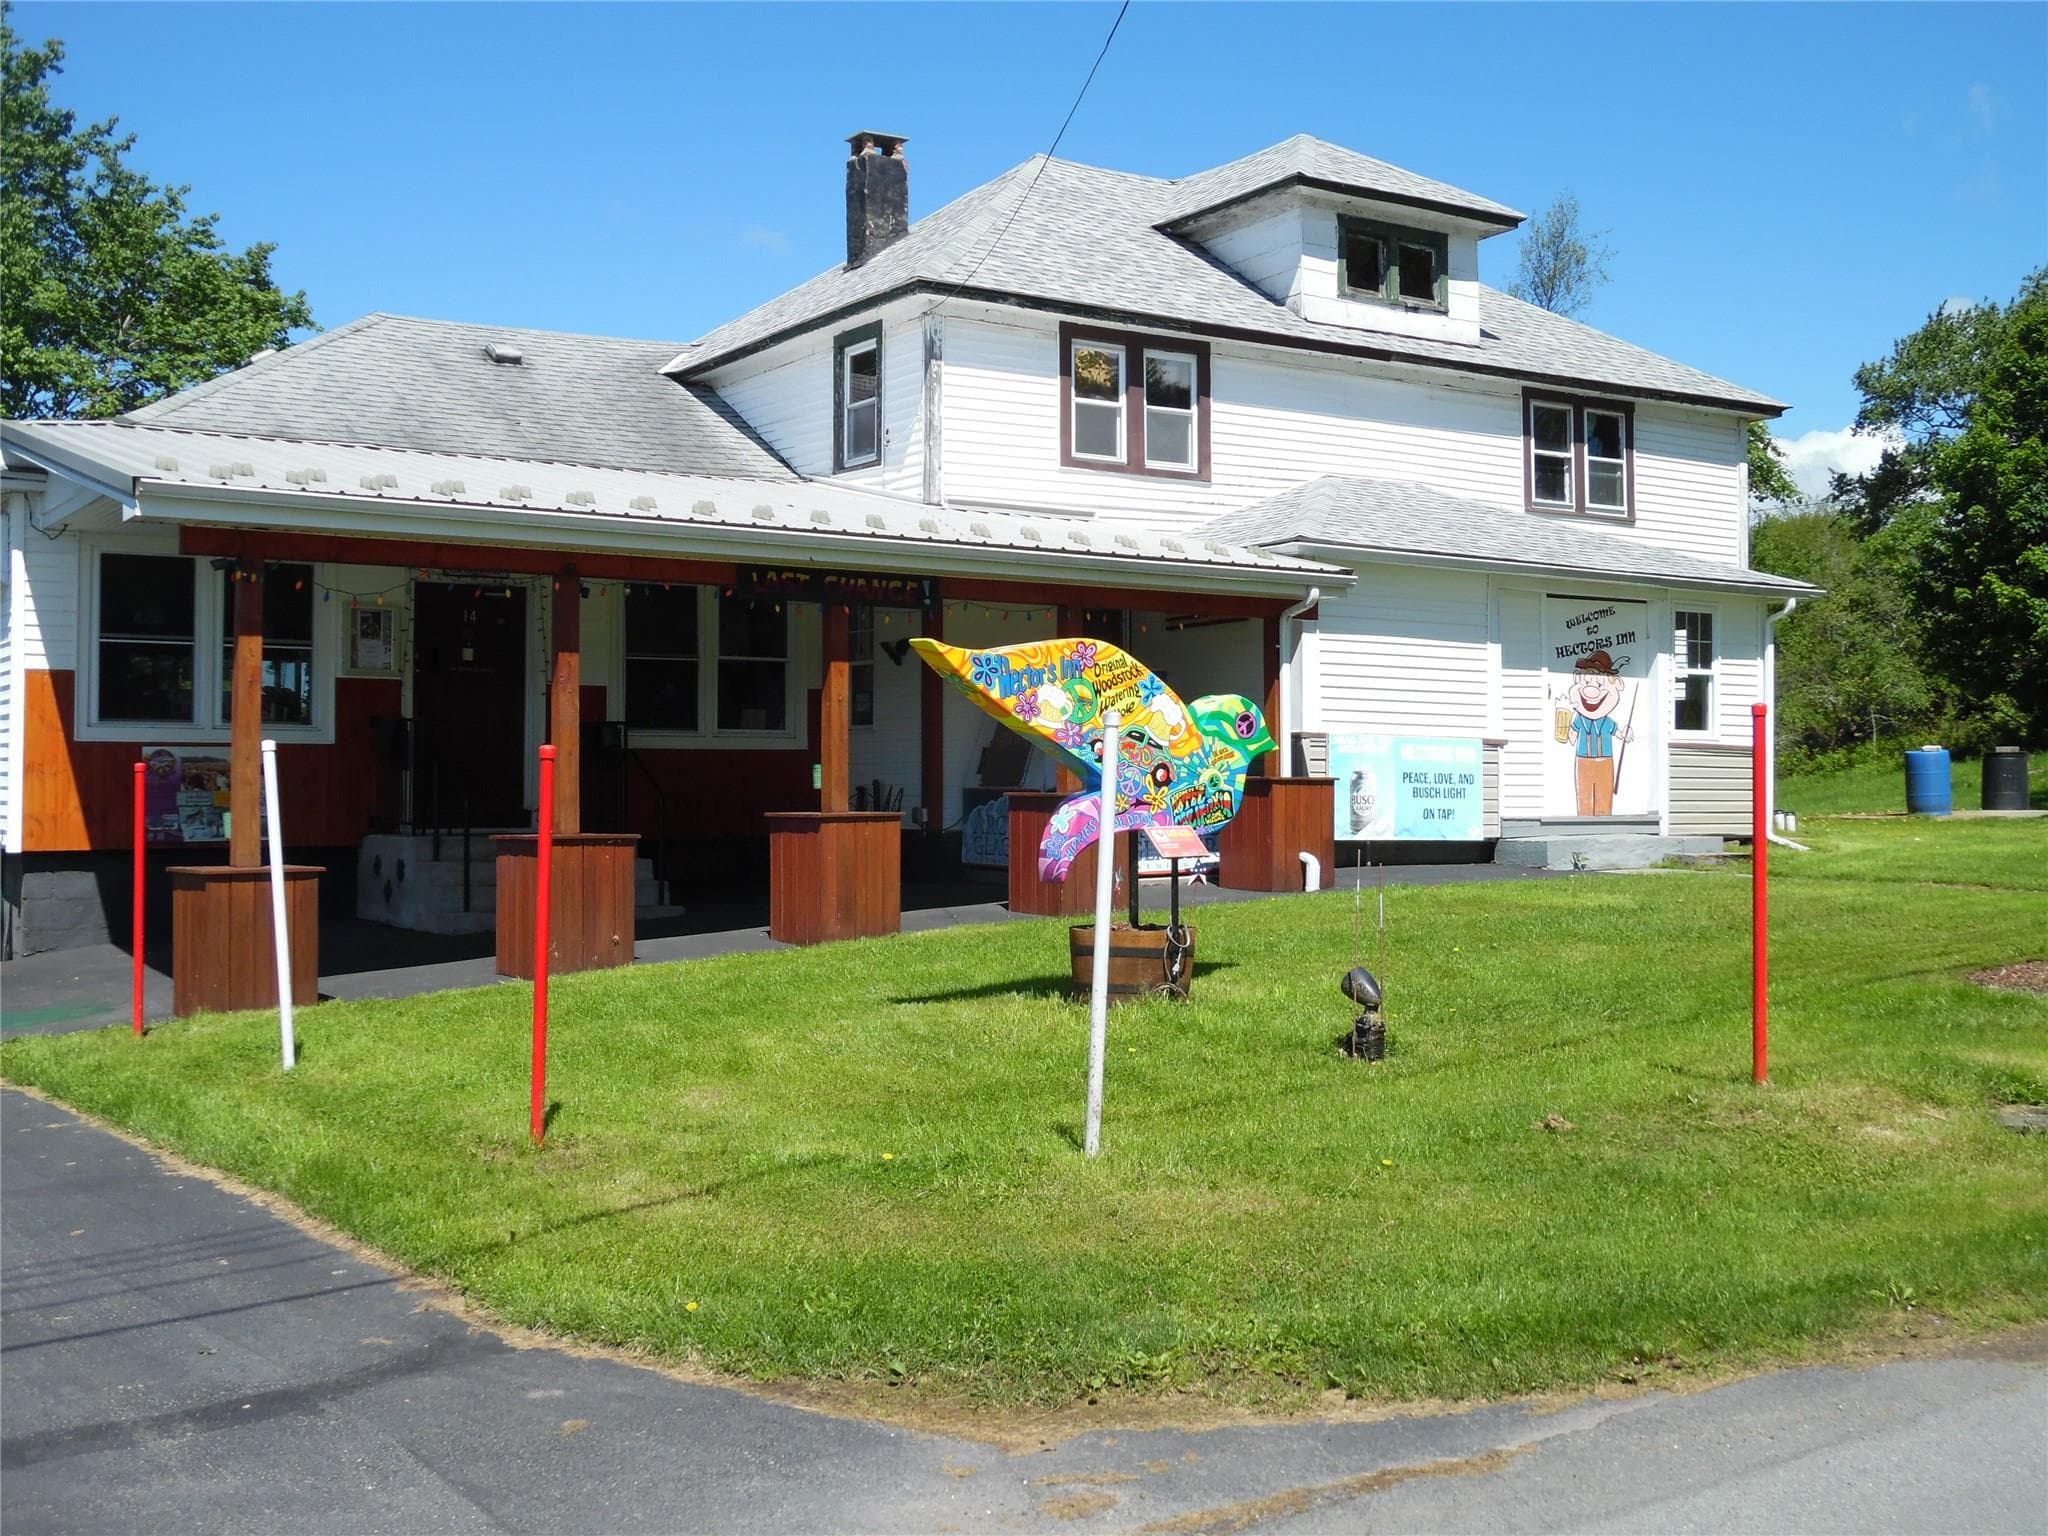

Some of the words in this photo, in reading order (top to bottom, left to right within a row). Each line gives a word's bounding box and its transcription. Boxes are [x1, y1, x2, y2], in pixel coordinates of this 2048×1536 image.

[463, 609, 477, 623] 14
[1566, 606, 1616, 629] WELCOME
[1555, 635, 1613, 658] HECTORS
[996, 654, 1058, 699] Hector's
[1060, 655, 1083, 680] Inn
[1093, 653, 1129, 678] Original
[1092, 661, 1144, 699] Woodstock
[1099, 681, 1142, 716] Watering
[1402, 772, 1431, 785] PEACE,
[1433, 773, 1456, 786] LOVE,
[1458, 773, 1475, 785] AND
[1412, 787, 1441, 799] BUSCH
[1443, 787, 1467, 799] LIGHT
[1422, 808, 1435, 819] ON
[1437, 809, 1455, 820] TAP!
